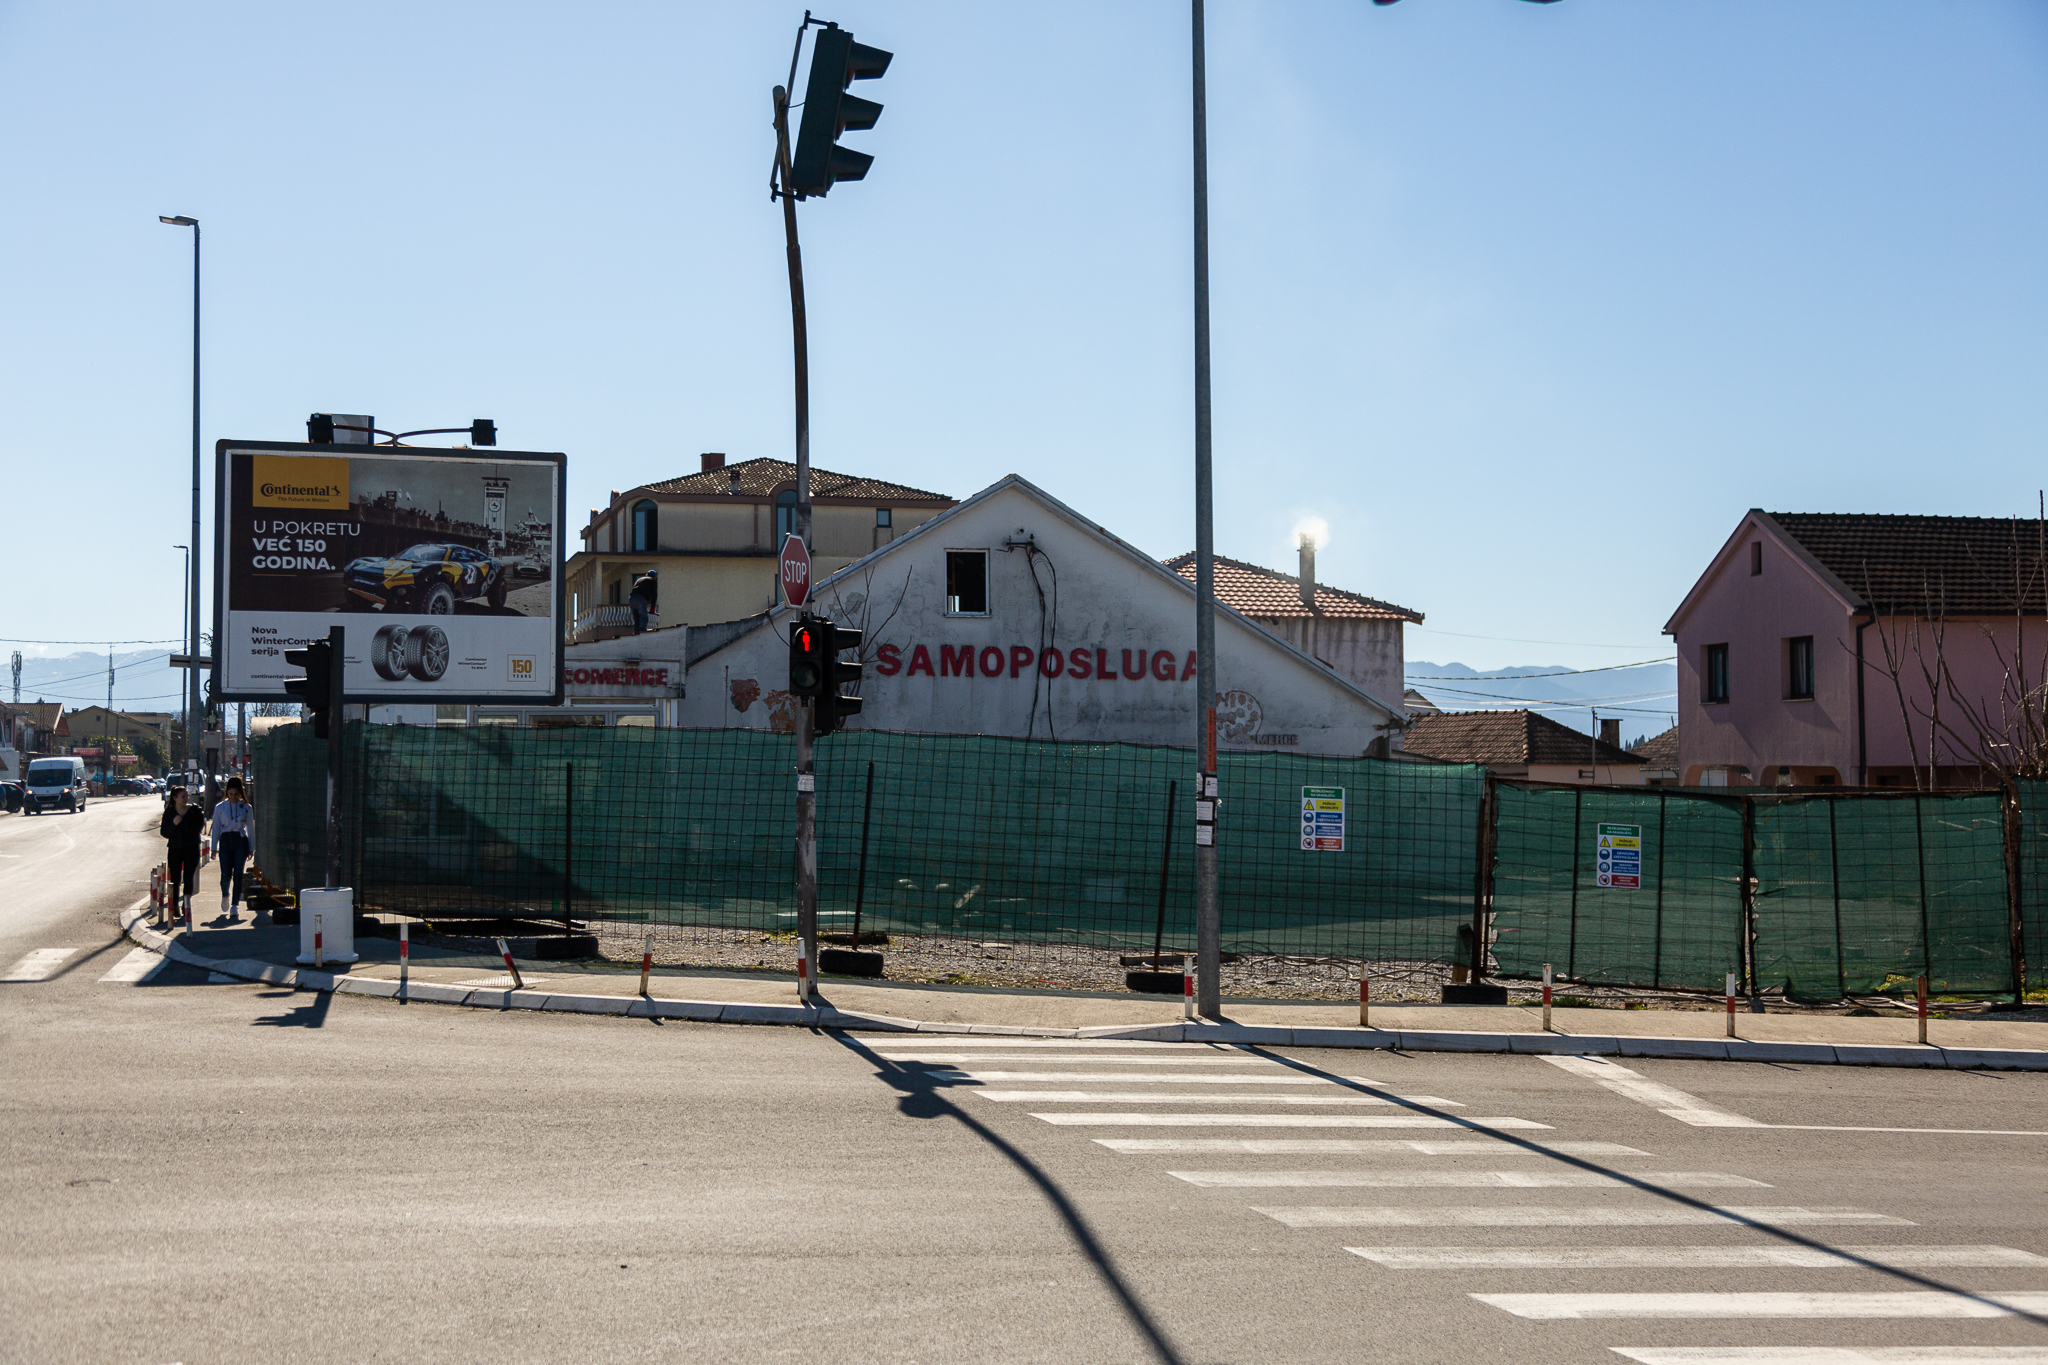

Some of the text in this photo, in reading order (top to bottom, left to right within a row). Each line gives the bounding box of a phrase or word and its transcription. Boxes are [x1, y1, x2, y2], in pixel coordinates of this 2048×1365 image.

[260, 483, 330, 498] Continental
[254, 520, 360, 536] U POKRETU
[252, 535, 327, 552] VEĆ 150
[252, 555, 336, 570] GODINA.
[785, 560, 807, 584] STOP
[252, 626, 278, 634] Nova
[251, 648, 279, 657] serija
[512, 660, 532, 673] 150
